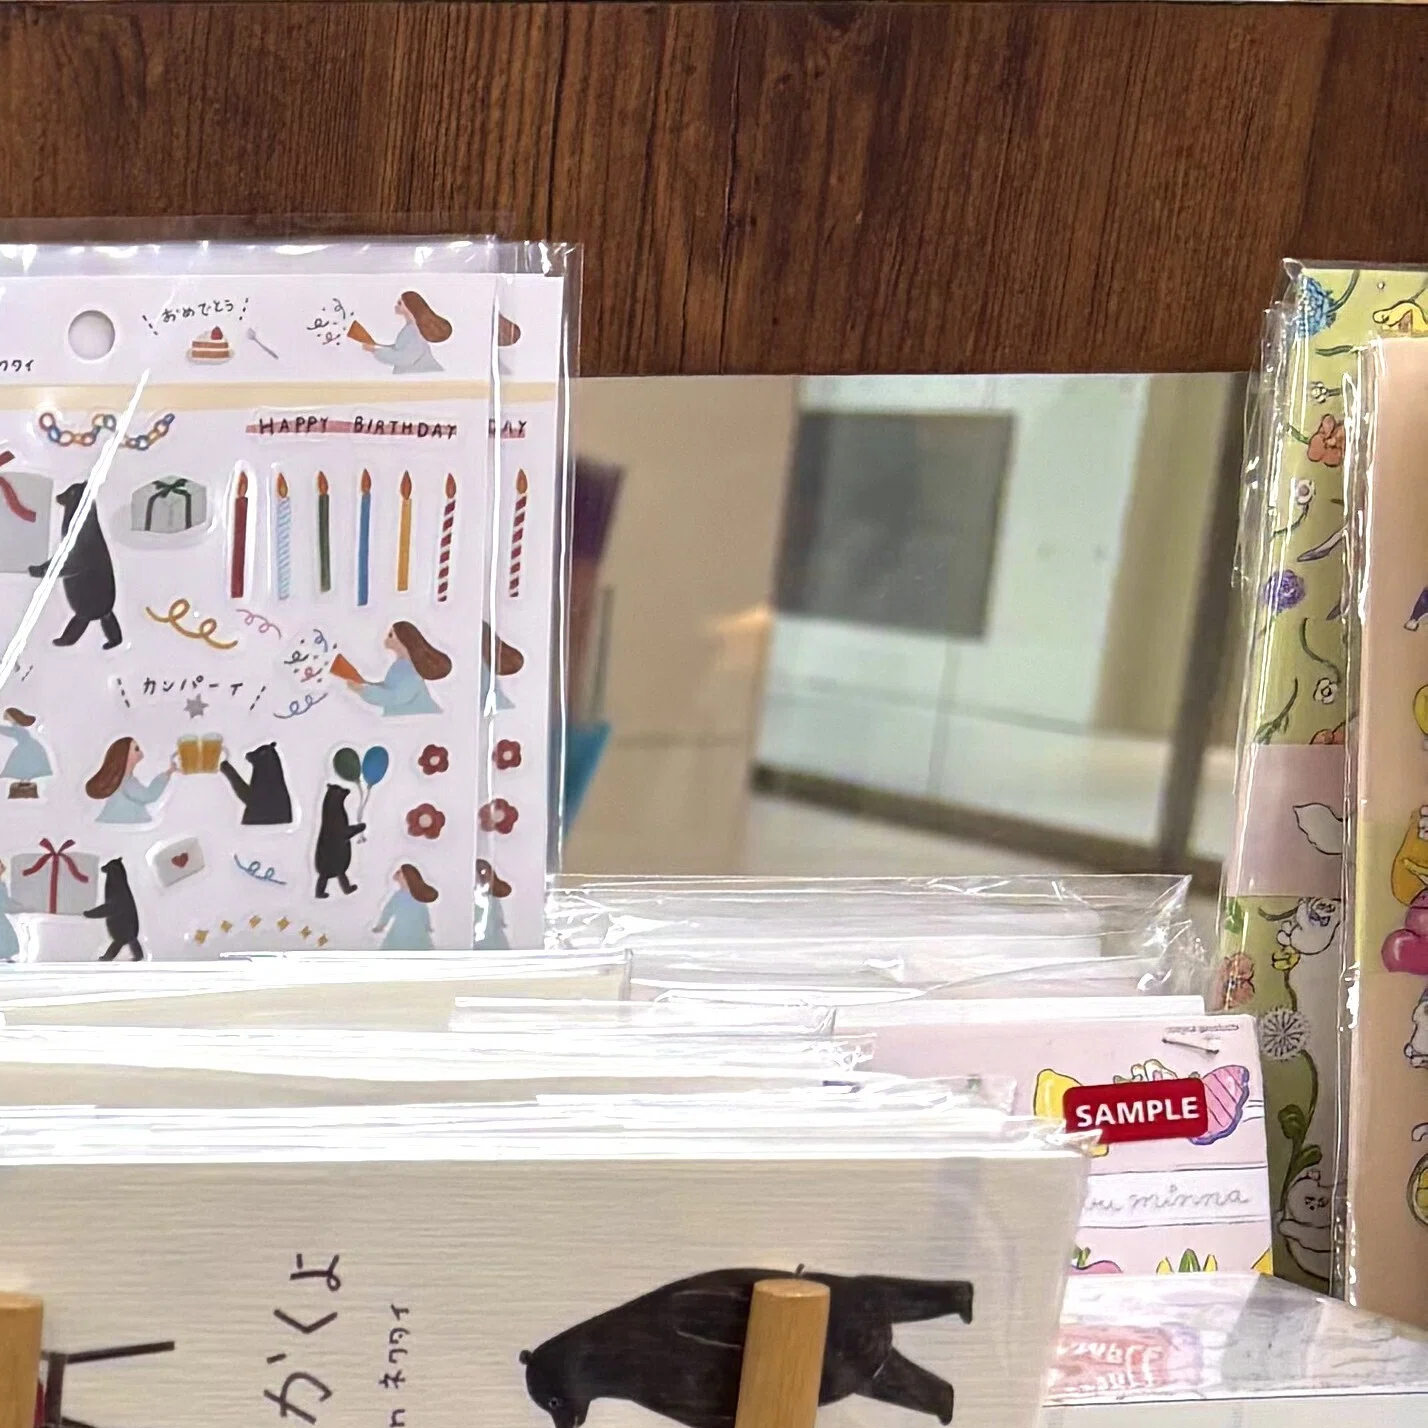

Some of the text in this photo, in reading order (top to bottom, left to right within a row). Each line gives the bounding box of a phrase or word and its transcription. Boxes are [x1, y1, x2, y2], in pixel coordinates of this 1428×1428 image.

[259, 415, 458, 440] HAPPY BIRTHDAY
[143, 677, 243, 697] カンパーイ
[1075, 1097, 1200, 1128] SAMPLE
